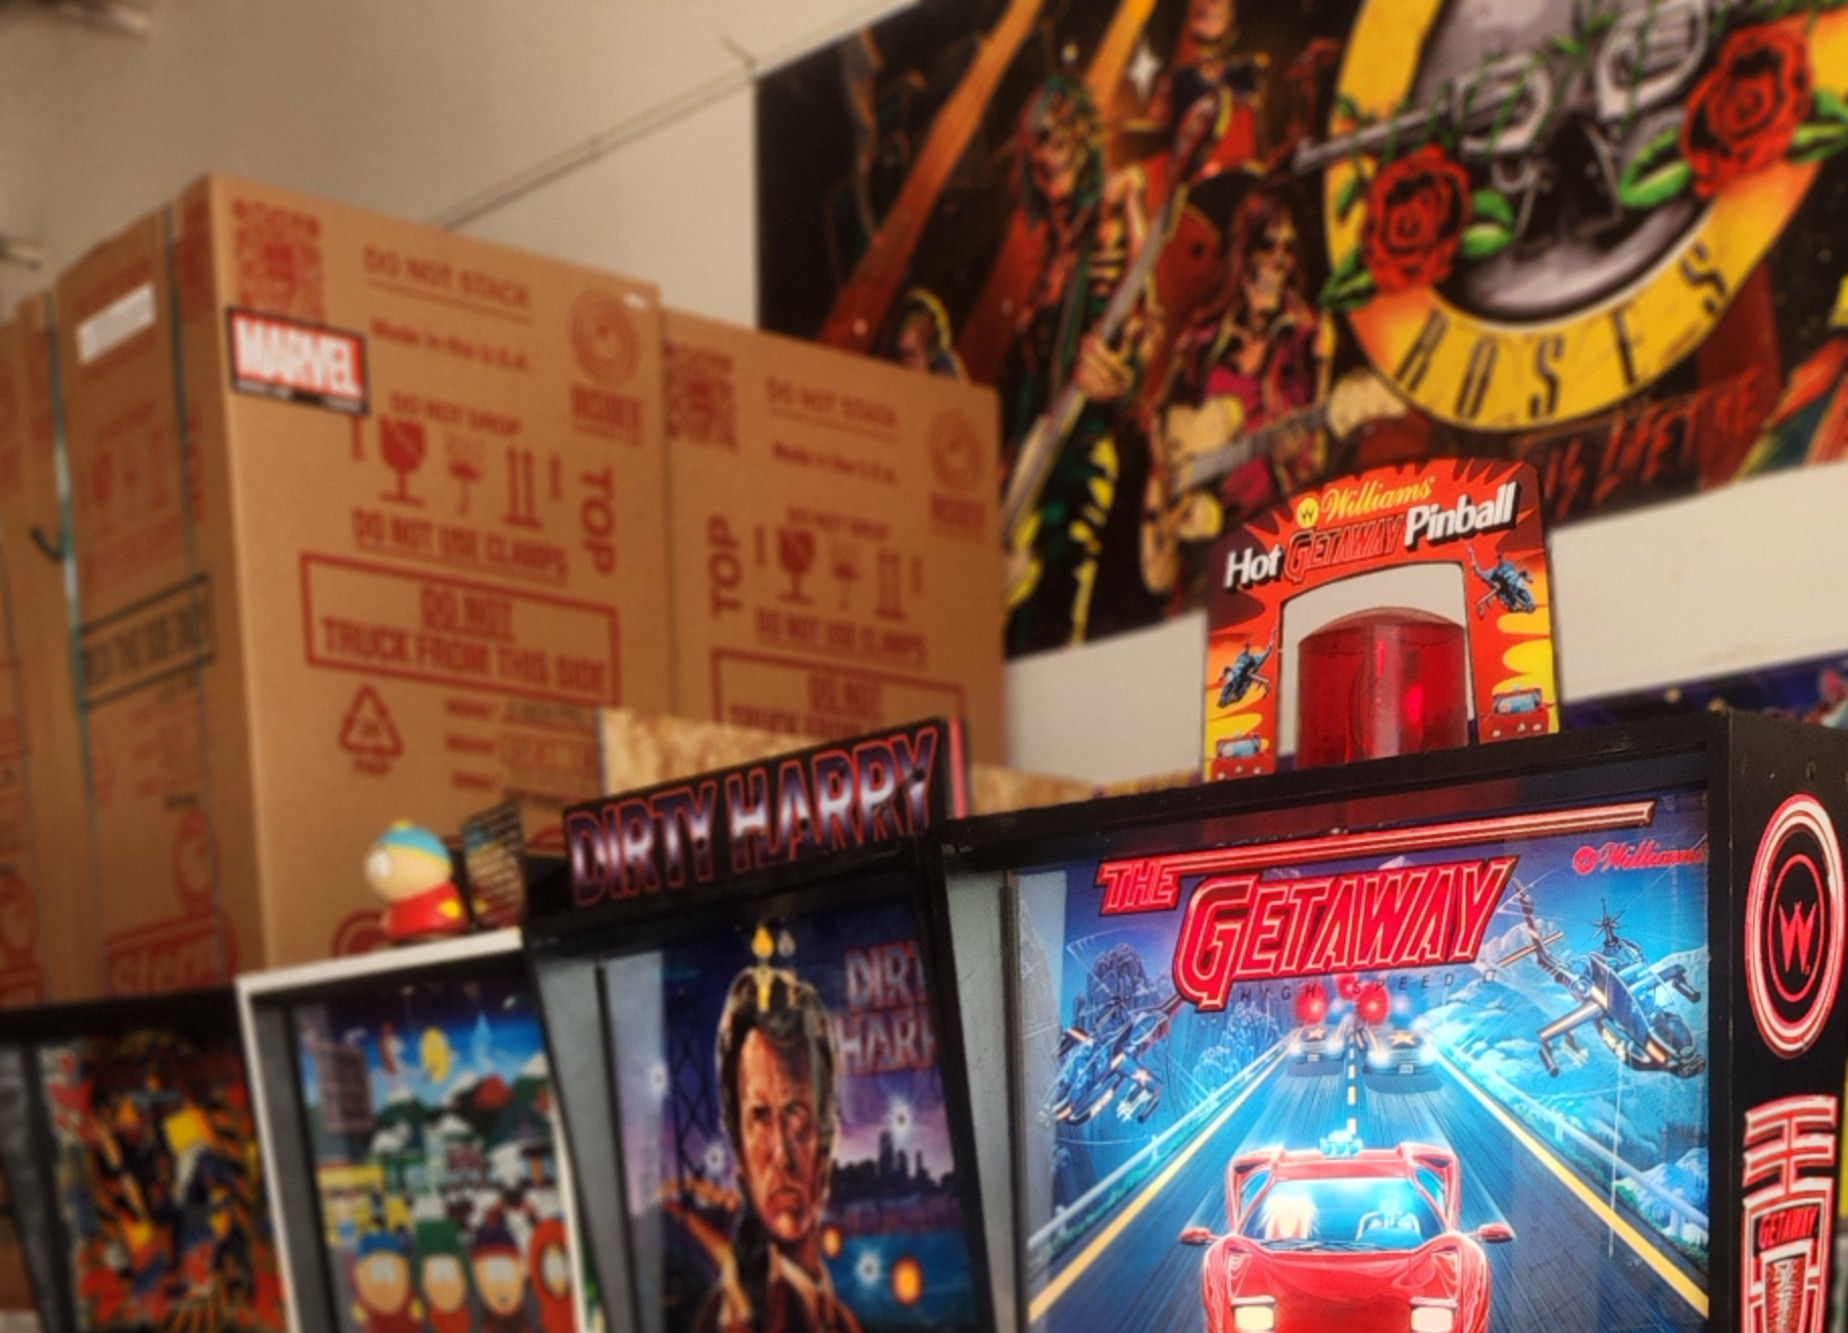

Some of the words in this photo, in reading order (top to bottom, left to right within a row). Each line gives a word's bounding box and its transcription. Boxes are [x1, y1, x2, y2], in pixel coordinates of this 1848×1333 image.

[234, 315, 363, 398] MARVEL
[1394, 241, 1726, 422] ROSES
[580, 465, 616, 575] TOP
[1225, 544, 1283, 588] Hot
[1284, 514, 1406, 582] GETAWAY
[1404, 481, 1517, 548] Pinball
[1322, 478, 1432, 522] Williams
[706, 514, 742, 622] TOP
[566, 778, 718, 909] DIRTY
[725, 726, 940, 876] HARRY
[1598, 838, 1707, 873] Williams
[845, 940, 927, 1009] DIRT
[1097, 861, 1180, 915] THE
[1174, 856, 1518, 1011] GETAWAY
[1240, 981, 1317, 1002] HIGH
[1352, 972, 1455, 995] SPEED
[1759, 1203, 1819, 1250] GETAWAY
